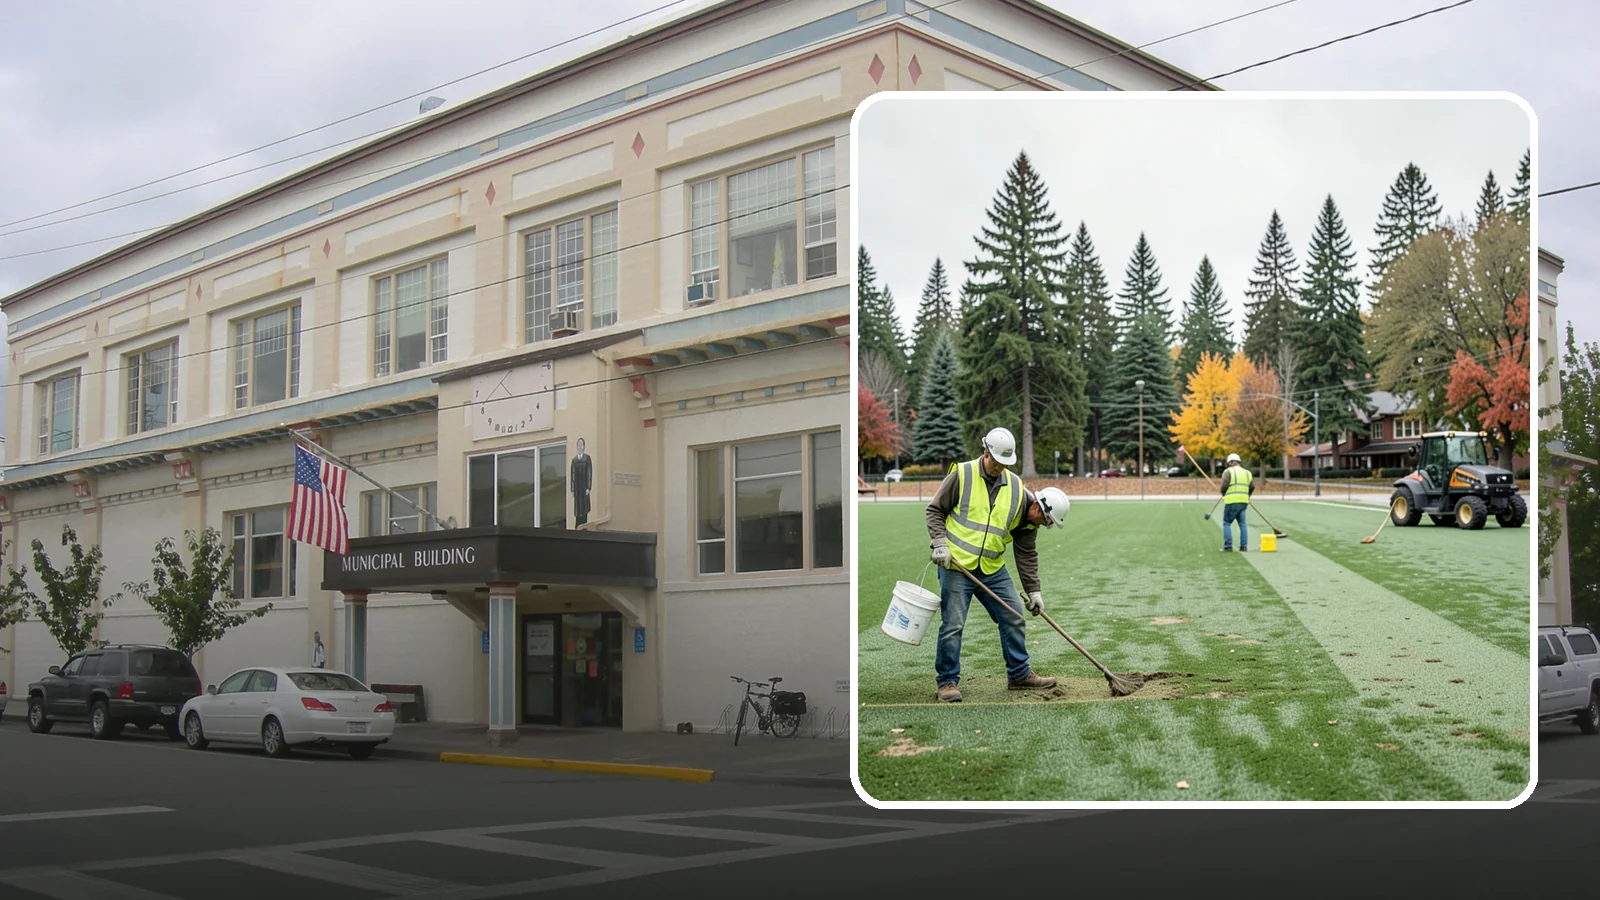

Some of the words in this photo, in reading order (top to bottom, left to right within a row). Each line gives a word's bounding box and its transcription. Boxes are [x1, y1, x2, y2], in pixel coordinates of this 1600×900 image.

[476, 390, 479, 398] 7
[536, 402, 540, 410] 4
[481, 406, 485, 415] 8
[488, 418, 492, 426] 9
[529, 414, 533, 422] 3
[494, 424, 500, 432] 10
[521, 420, 525, 428] 2
[508, 425, 513, 433] 12
[342, 552, 405, 572] MUNICIPAL
[414, 546, 475, 567] BUILDING
